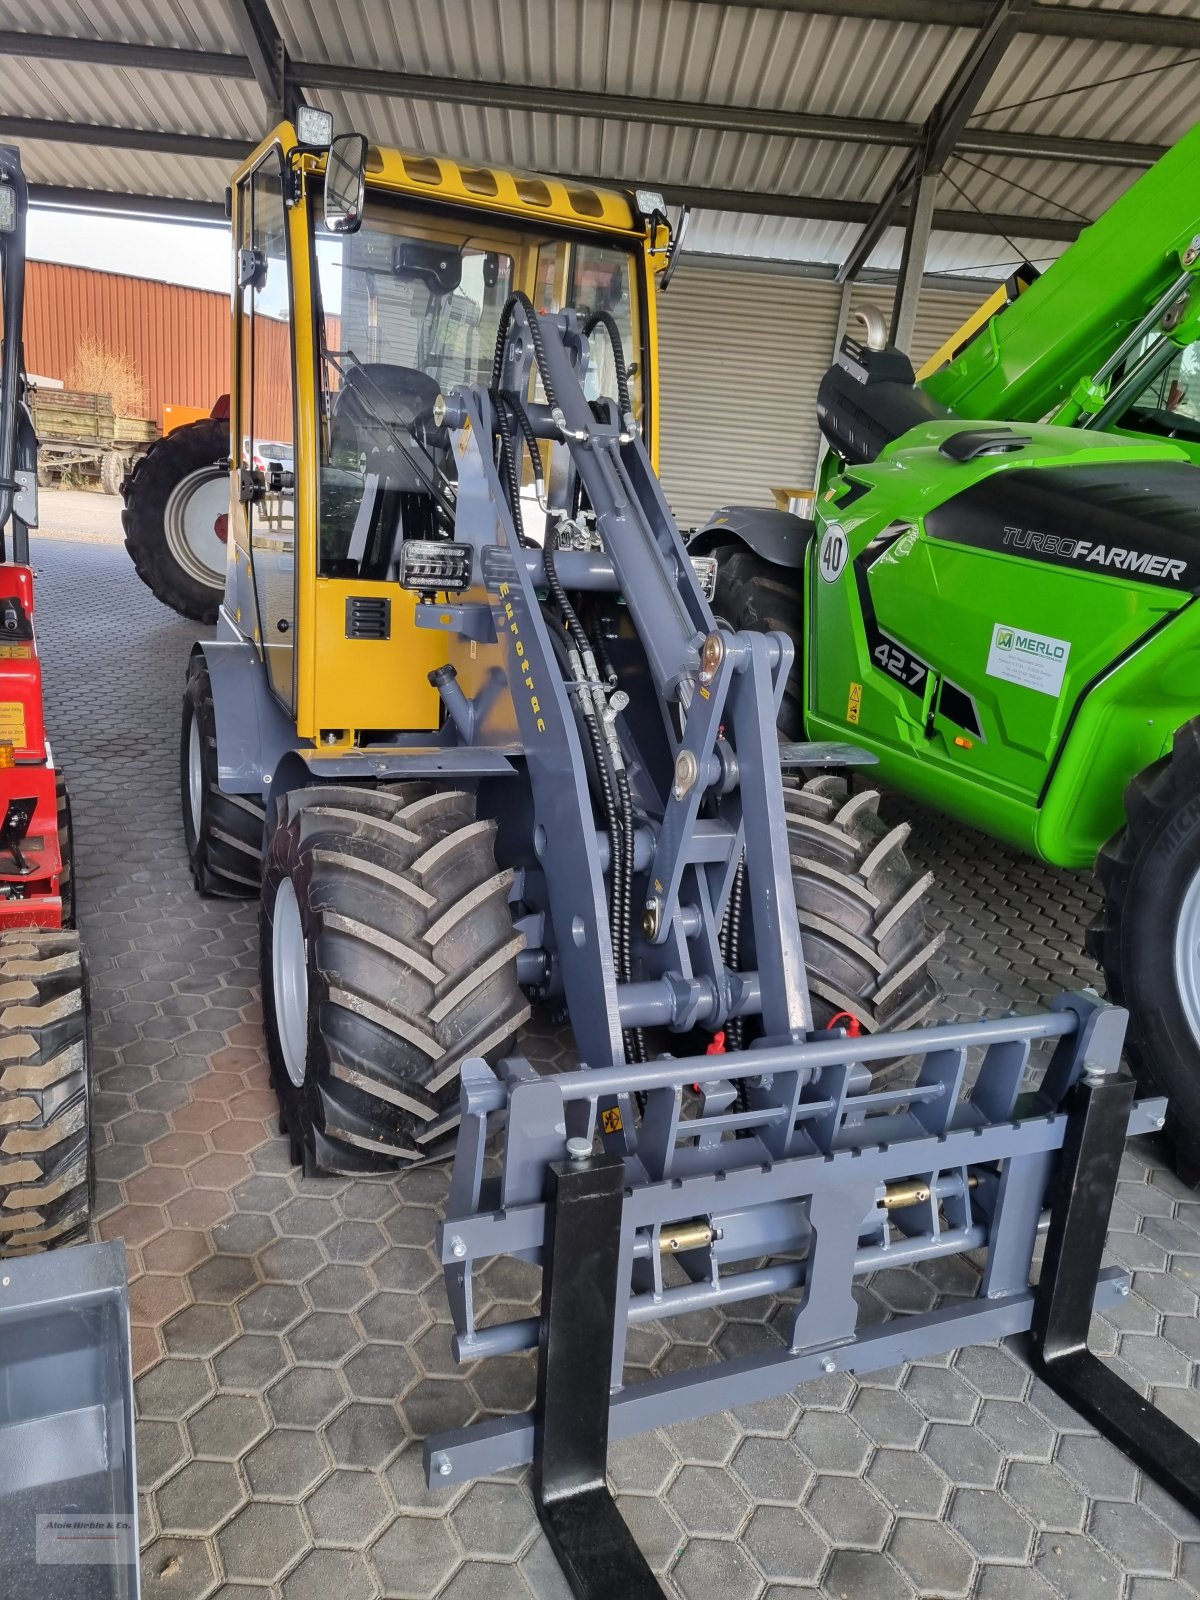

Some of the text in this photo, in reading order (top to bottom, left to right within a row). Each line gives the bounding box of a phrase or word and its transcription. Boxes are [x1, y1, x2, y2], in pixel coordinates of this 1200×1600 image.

[823, 535, 842, 572] 40
[499, 581, 546, 733] Eurotrac
[873, 643, 927, 687] 42.7
[1015, 635, 1065, 659] MERLO
